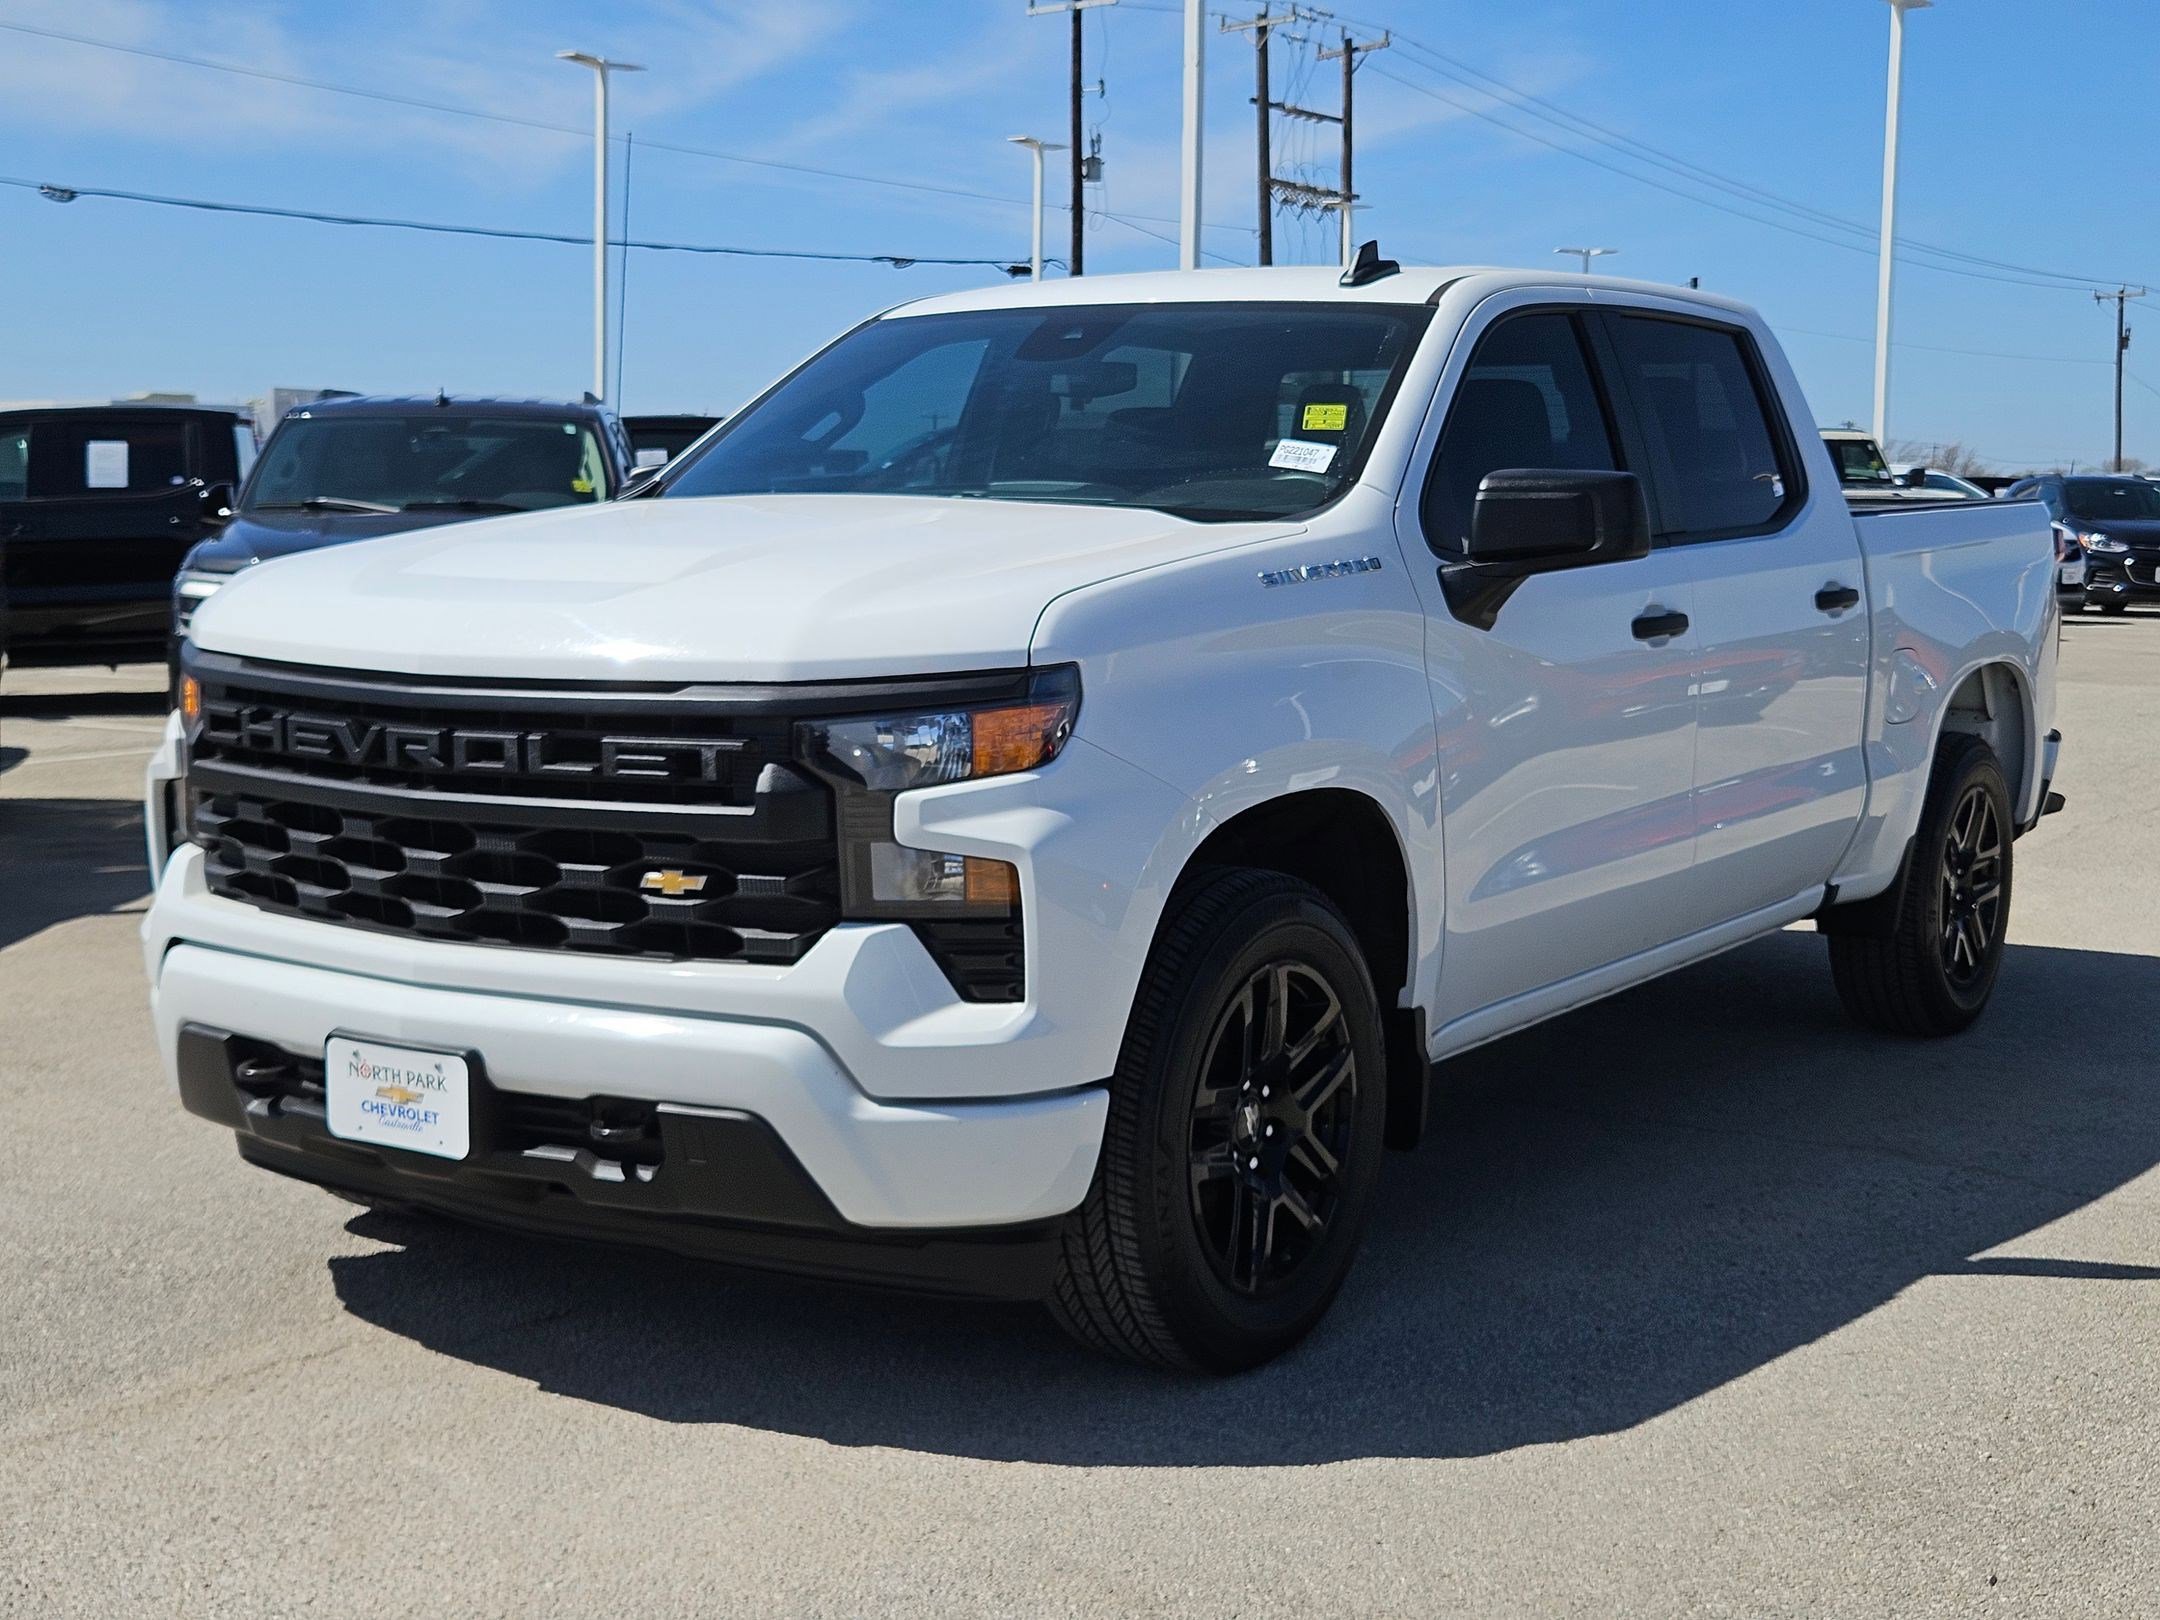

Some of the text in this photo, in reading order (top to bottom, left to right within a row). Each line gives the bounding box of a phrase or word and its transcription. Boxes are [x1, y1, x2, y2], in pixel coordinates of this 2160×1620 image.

[1257, 556, 1382, 588] SILVERADO
[202, 703, 752, 782] CHEVROLET
[349, 1060, 447, 1092] NORTH PARK
[361, 1100, 439, 1124] CHEVROLET
